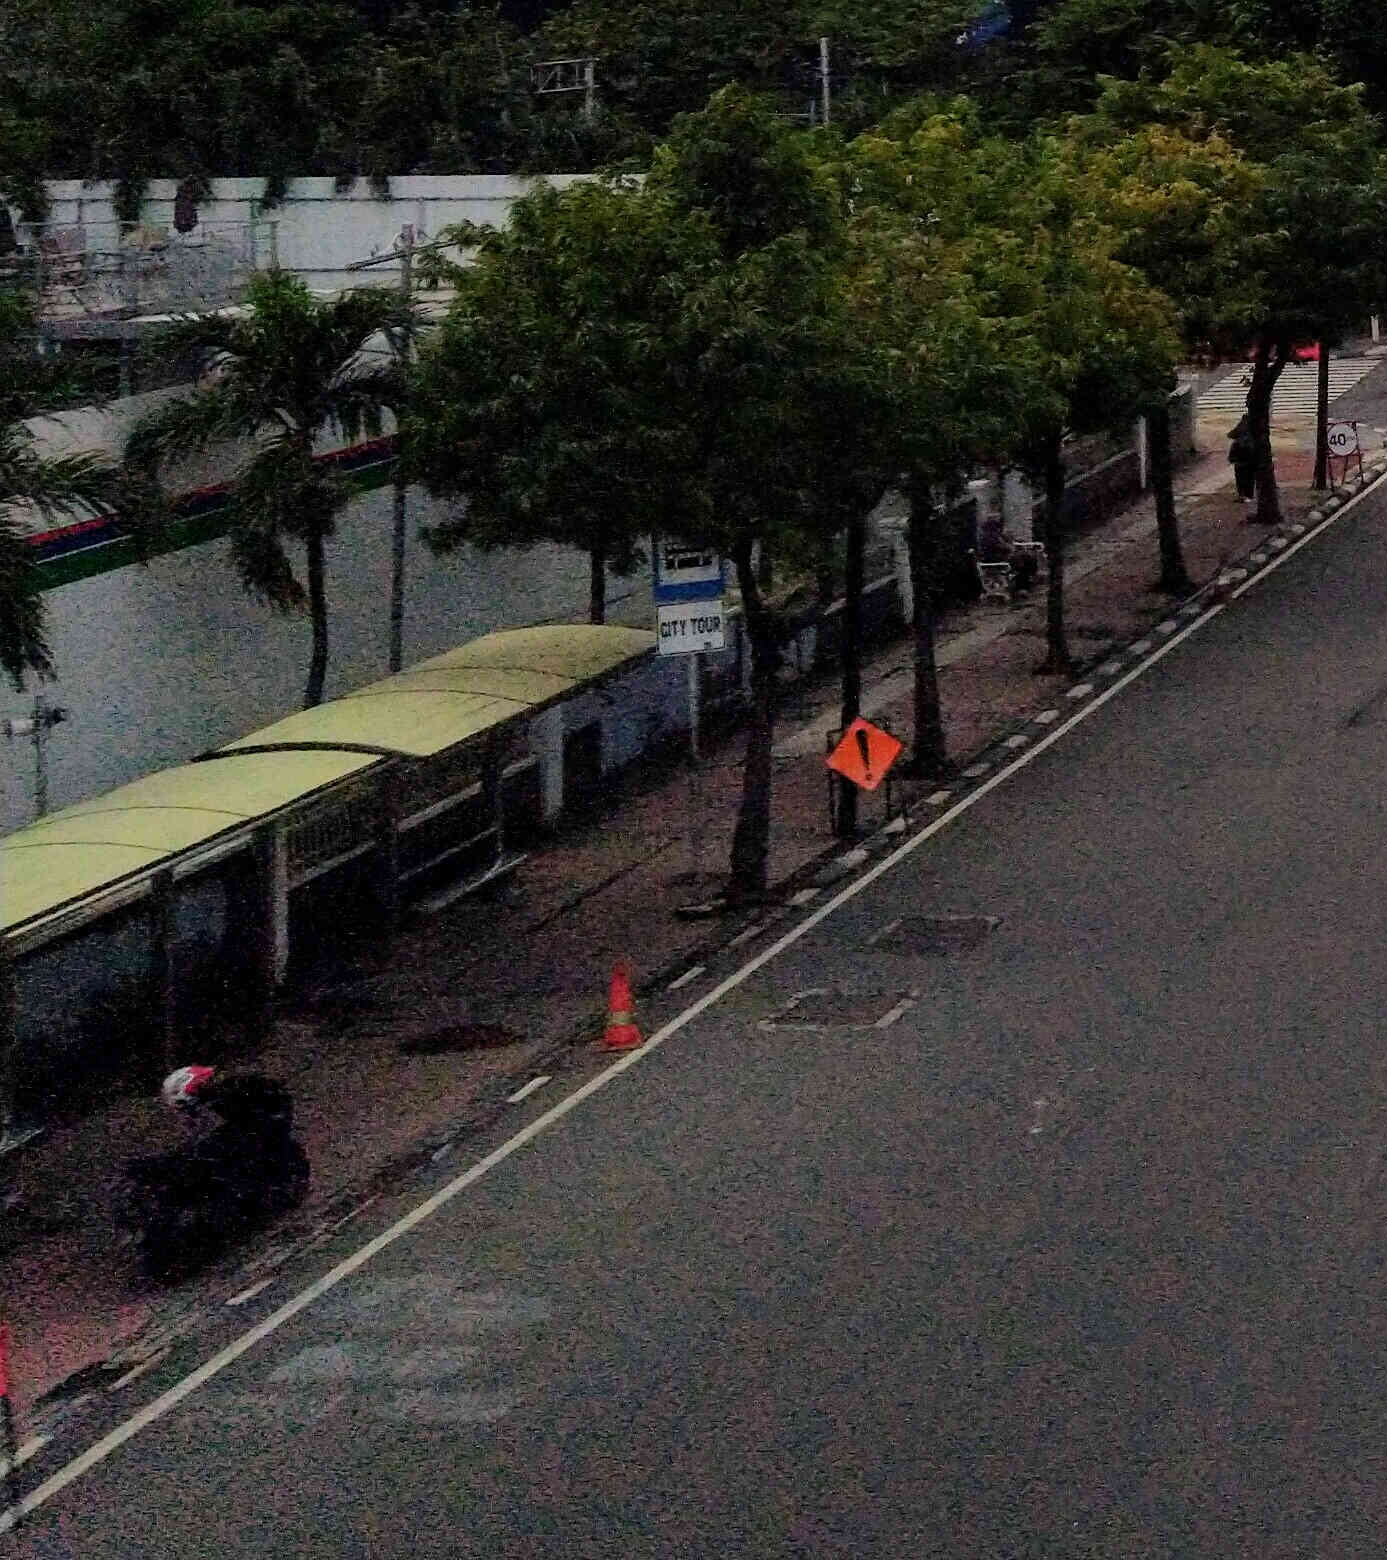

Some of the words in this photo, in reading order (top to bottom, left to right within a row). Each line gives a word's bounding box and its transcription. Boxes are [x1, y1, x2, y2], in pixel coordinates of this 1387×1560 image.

[1329, 433, 1346, 446] 40
[660, 619, 686, 638] CITY
[690, 616, 721, 634] TOUR
